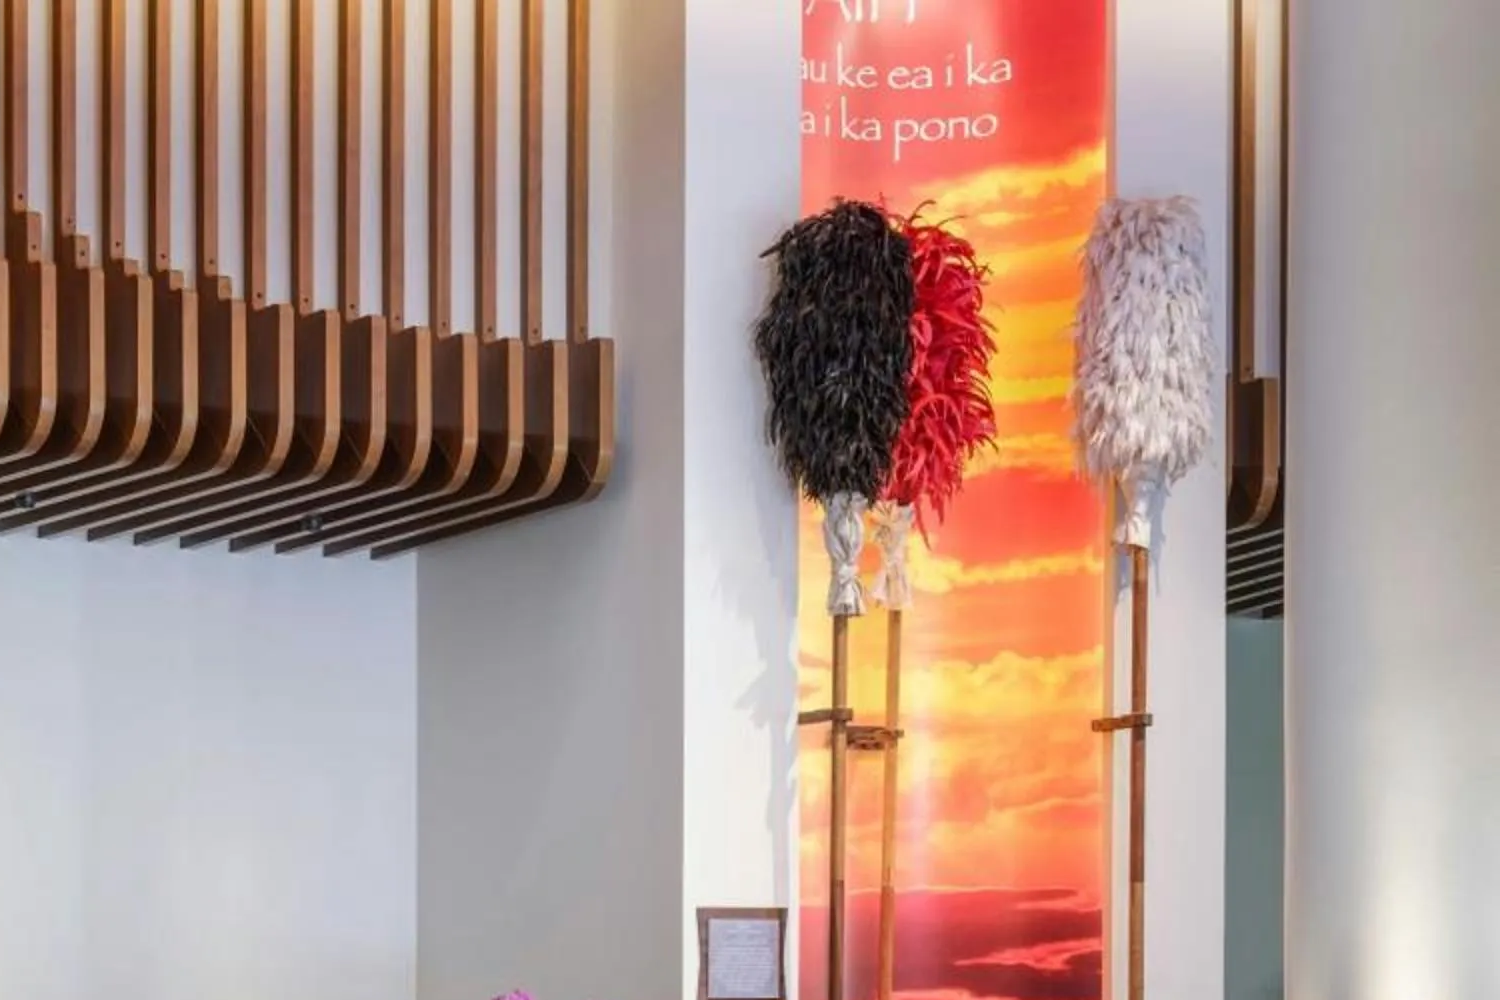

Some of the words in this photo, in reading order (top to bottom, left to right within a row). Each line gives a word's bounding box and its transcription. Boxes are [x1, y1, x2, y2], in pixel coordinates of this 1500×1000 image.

[837, 42, 878, 88] ke
[888, 65, 933, 89] ea
[945, 53, 956, 87] i
[966, 43, 1013, 86] ka
[824, 101, 832, 138] i
[841, 95, 882, 141] ka
[893, 113, 998, 163] pono
